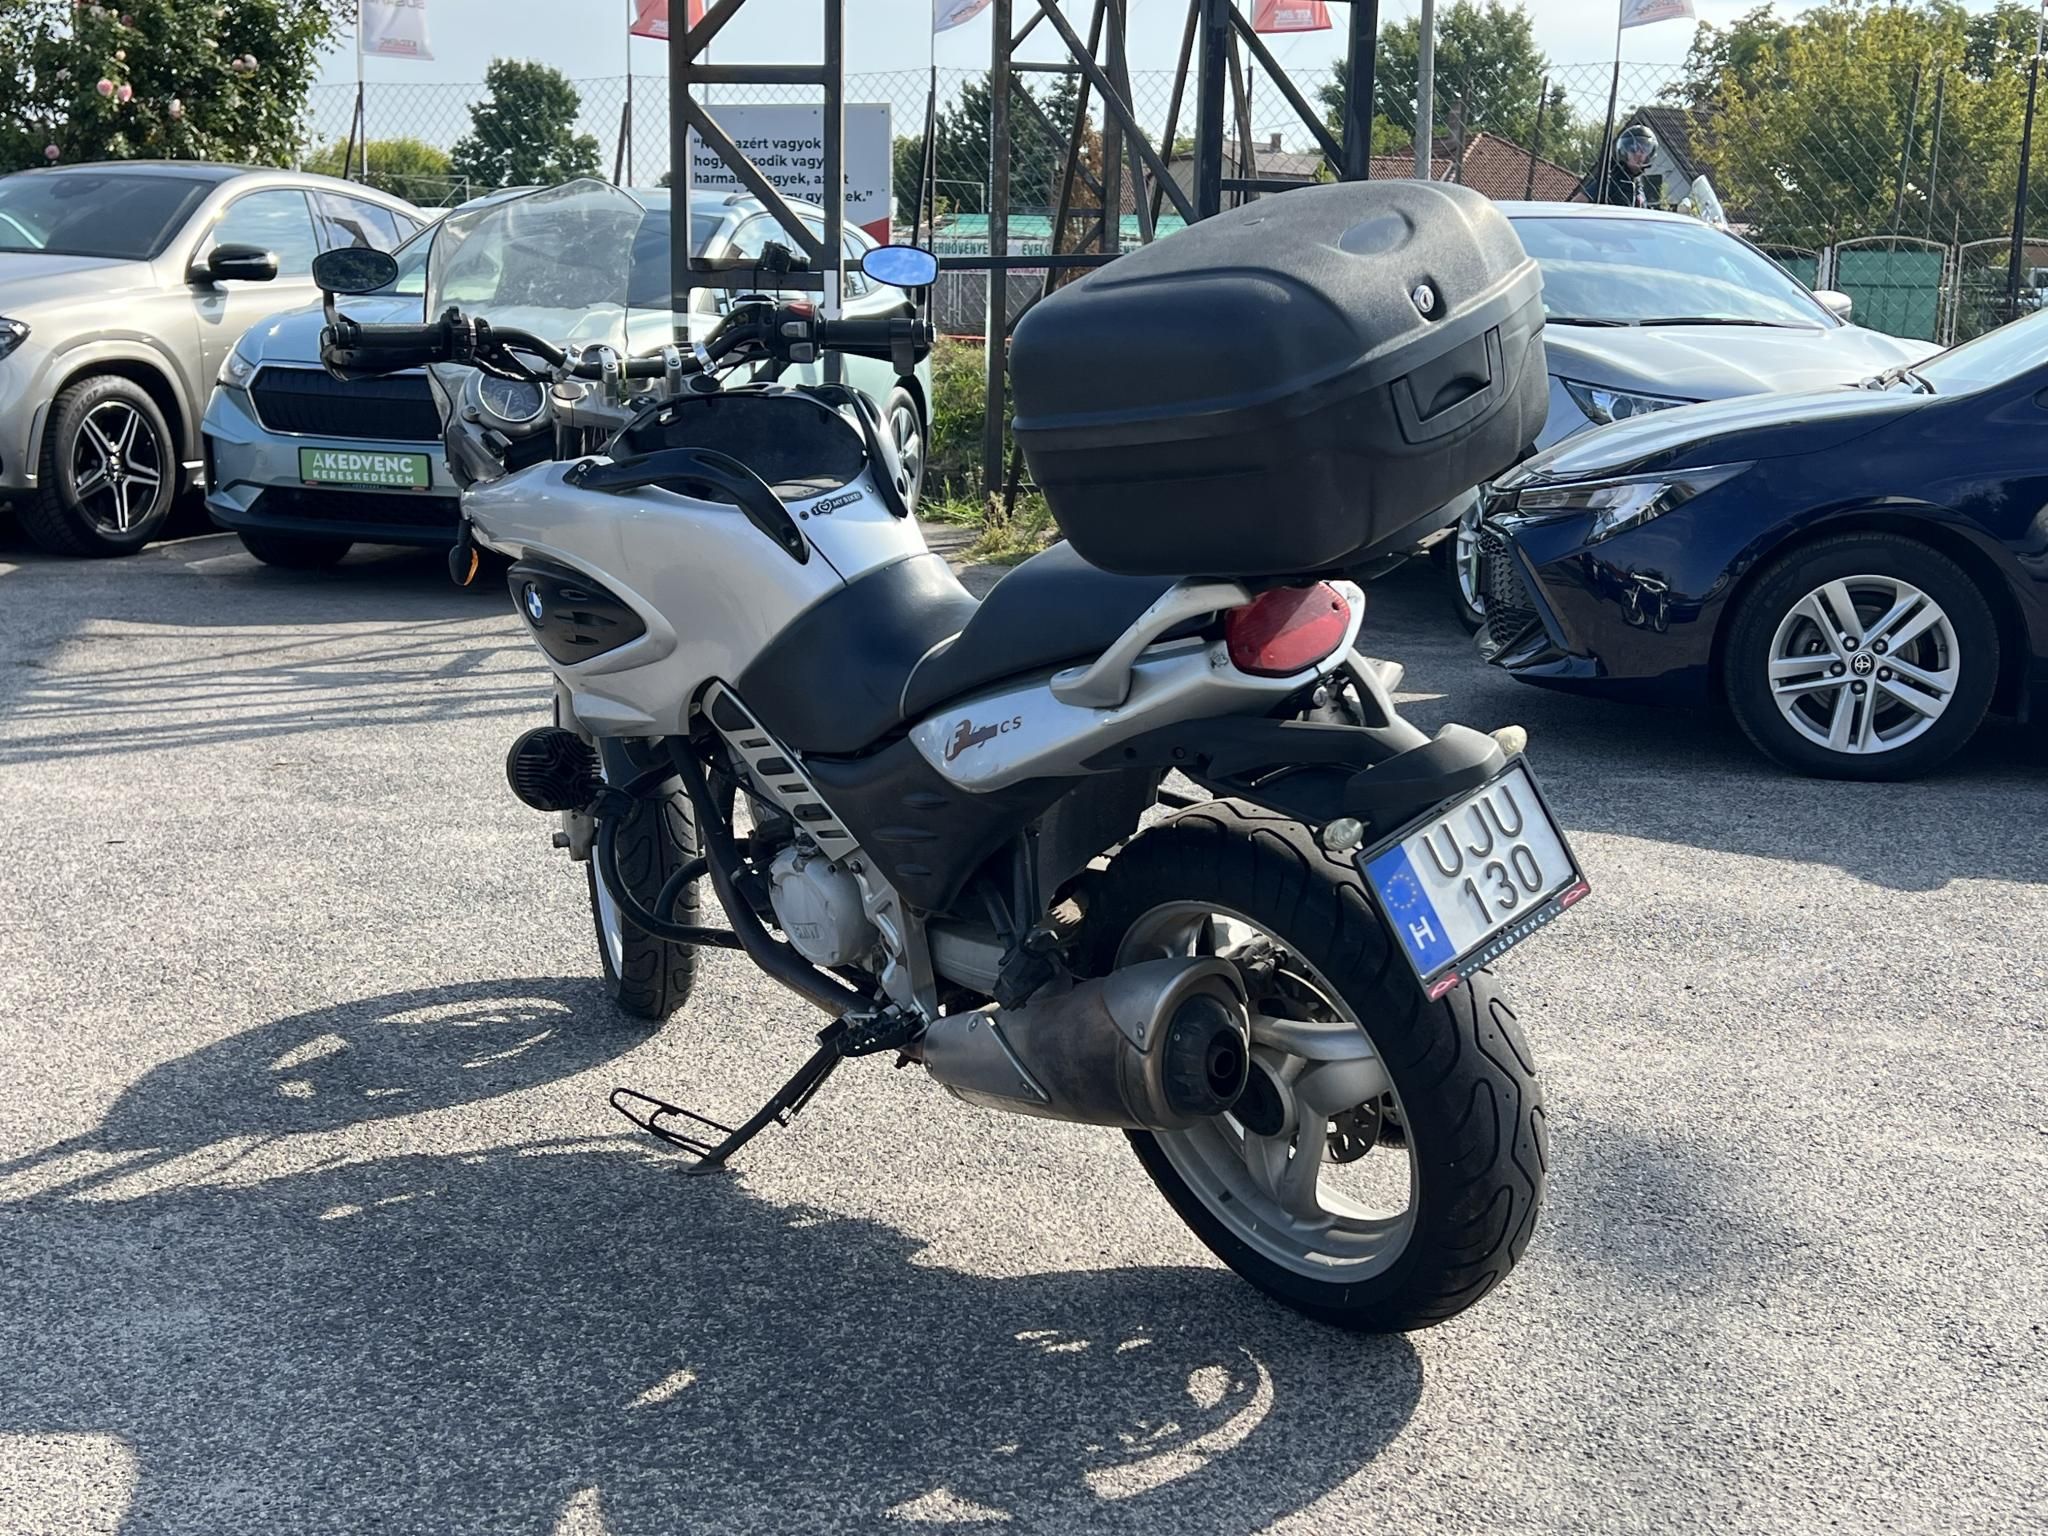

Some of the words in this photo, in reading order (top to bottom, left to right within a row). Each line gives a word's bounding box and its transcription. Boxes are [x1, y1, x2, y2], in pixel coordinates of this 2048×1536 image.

[772, 137, 821, 152] vagyok
[791, 157, 825, 169] vagy
[312, 452, 414, 474] AKEDVENC
[312, 469, 415, 484] KERESKEDÉSEM
[1421, 783, 1524, 879] UJU
[1464, 844, 1544, 925] 130
[1408, 915, 1437, 951] H
